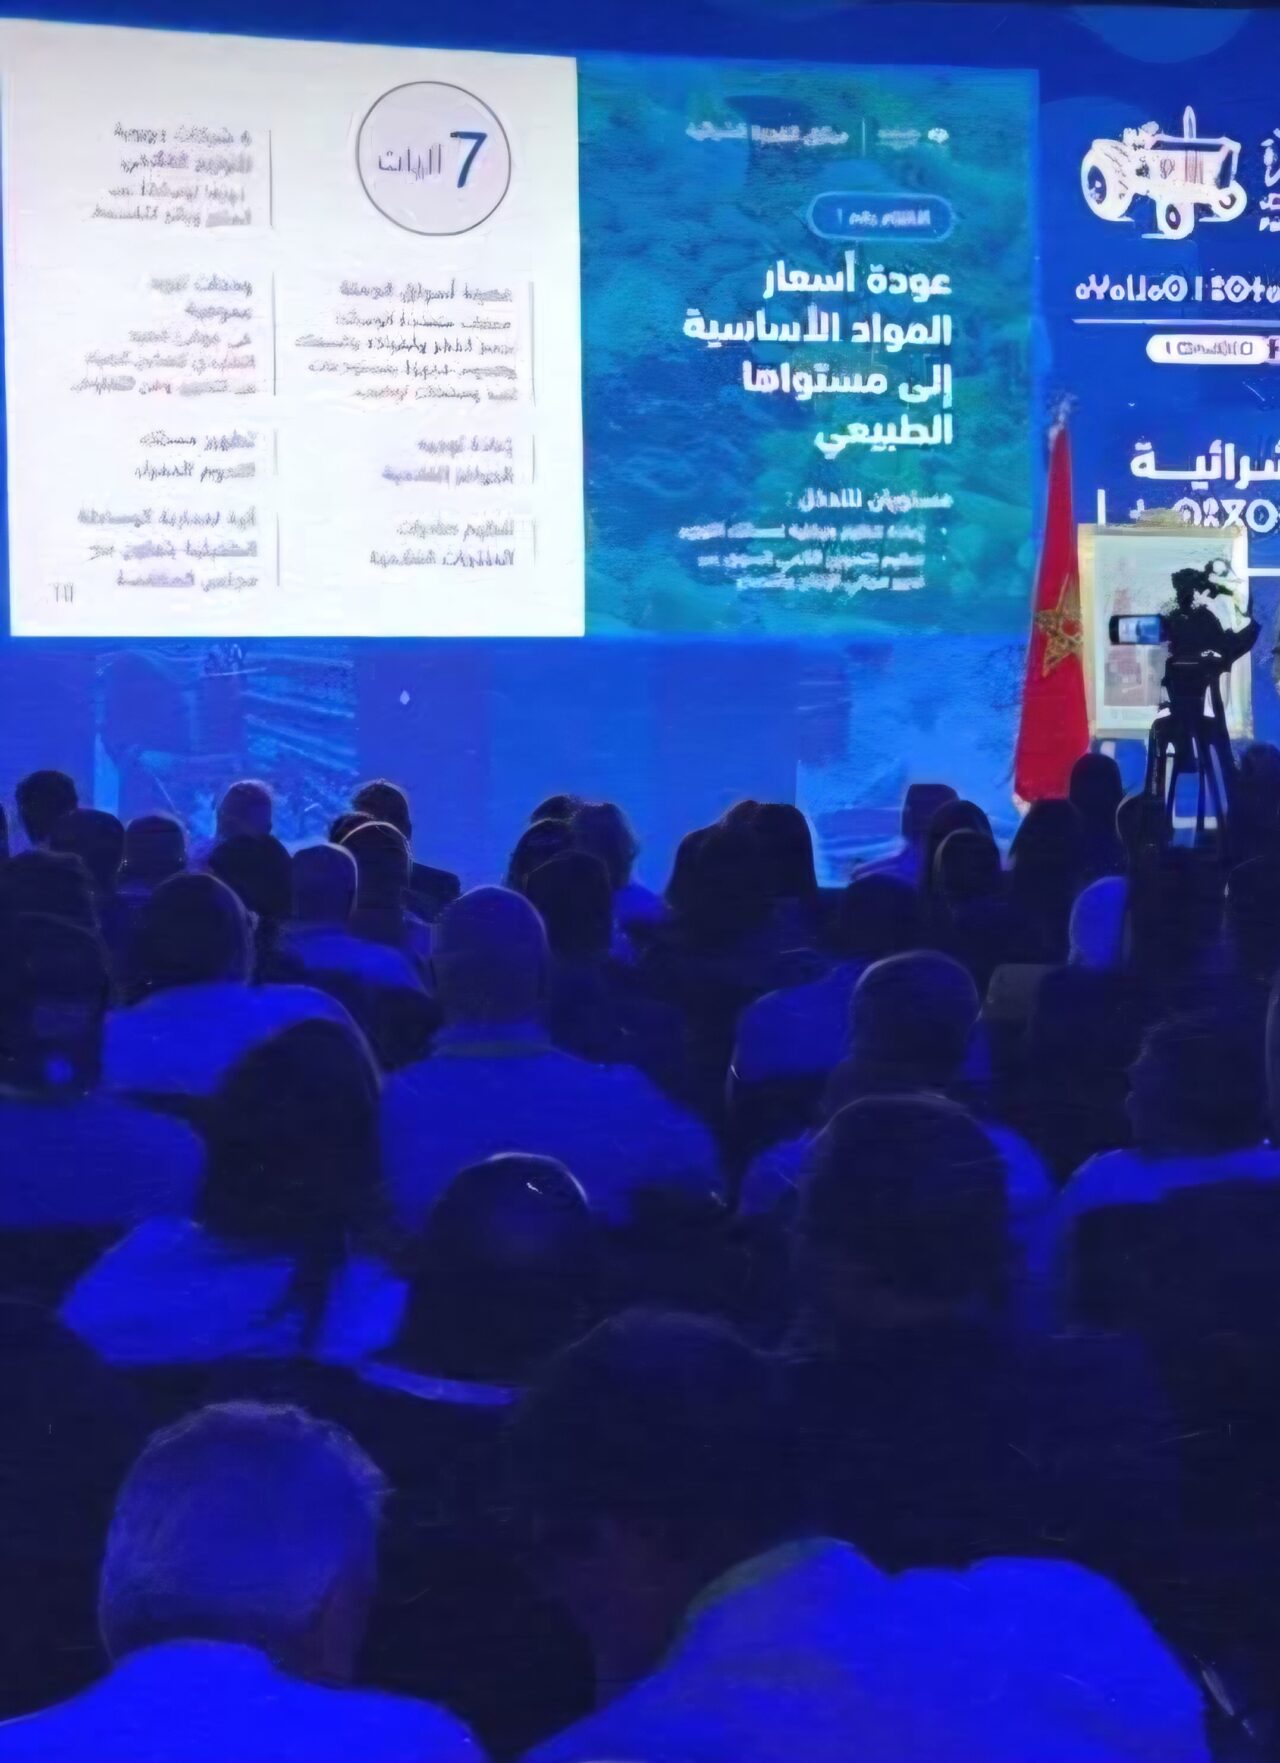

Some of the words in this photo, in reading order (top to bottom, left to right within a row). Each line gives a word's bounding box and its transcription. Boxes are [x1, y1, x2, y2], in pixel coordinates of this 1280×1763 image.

[450, 130, 488, 189] 7
[762, 249, 856, 300] أسعار
[866, 262, 953, 304] عودة
[682, 300, 843, 349] الأساسية
[851, 312, 953, 353] المواد
[741, 359, 889, 402] مستواها
[898, 363, 953, 410] إلى
[813, 413, 954, 461] الطبيعي
